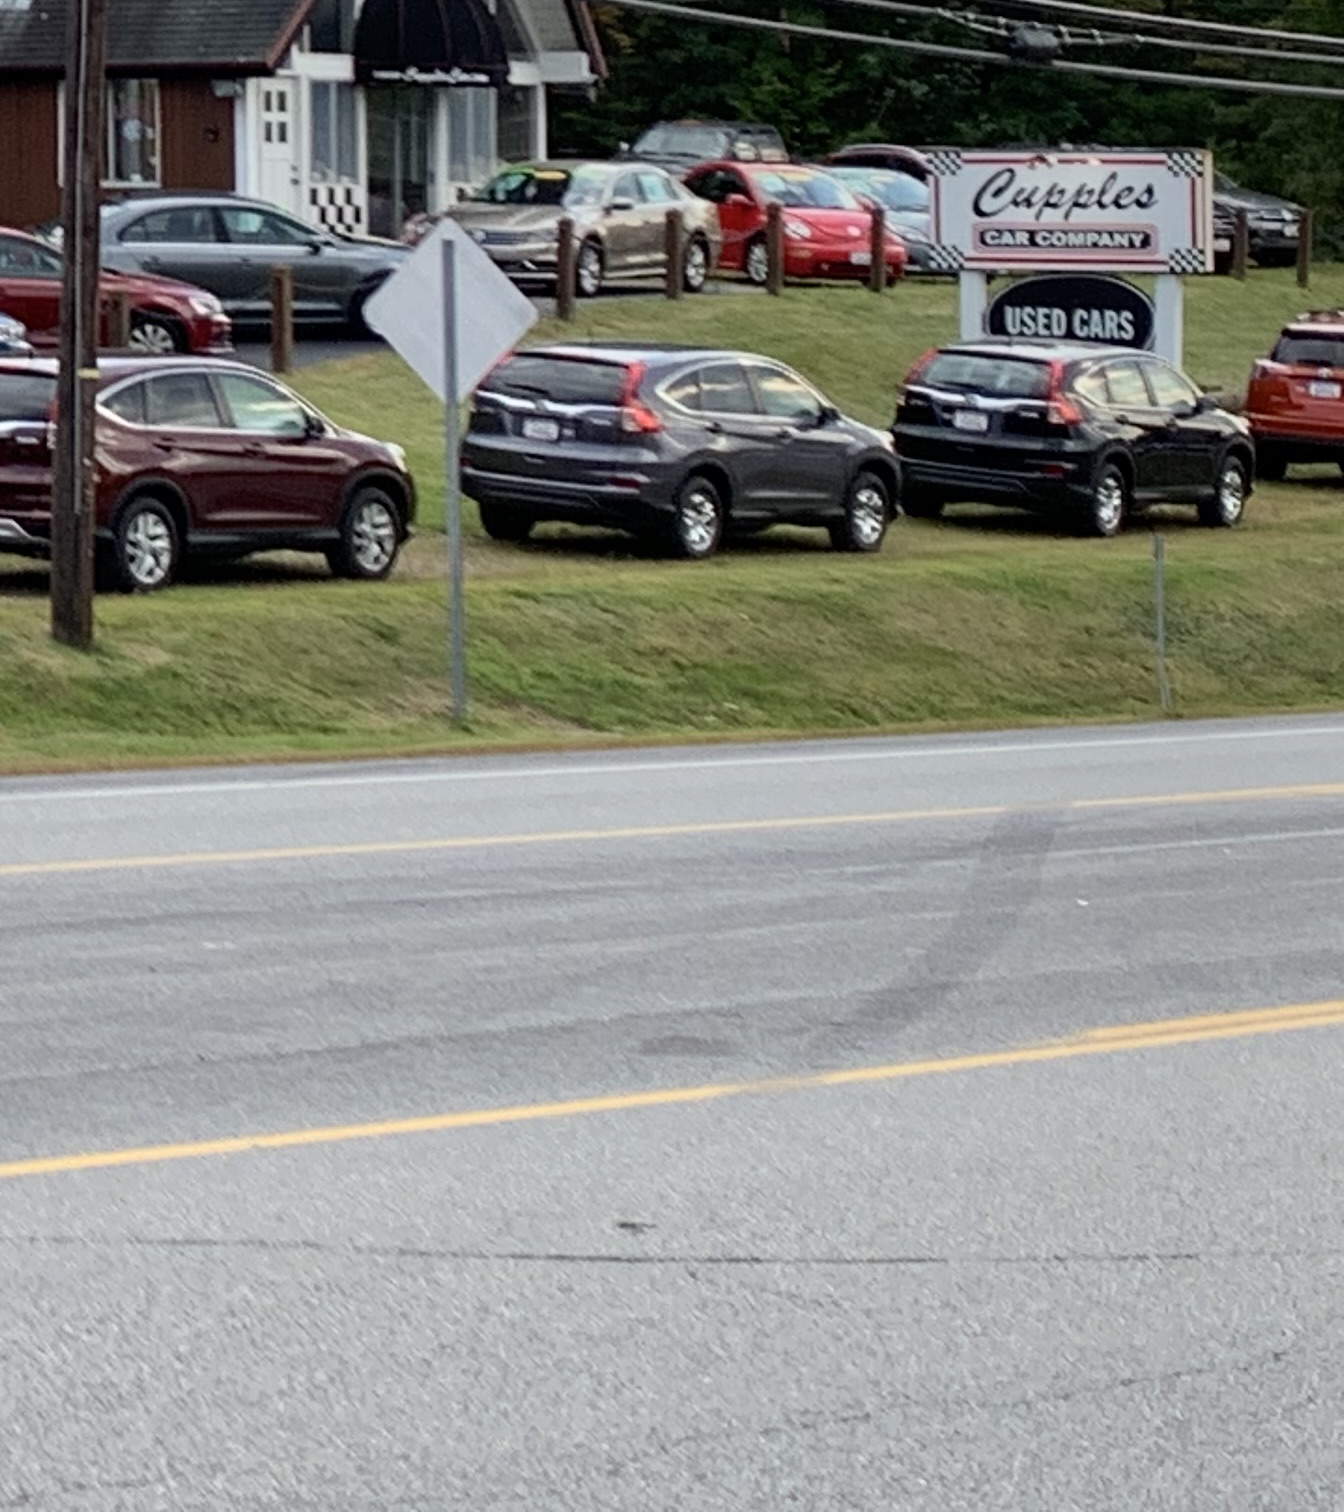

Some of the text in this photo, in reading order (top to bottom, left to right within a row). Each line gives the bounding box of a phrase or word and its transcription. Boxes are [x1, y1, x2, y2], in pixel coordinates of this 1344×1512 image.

[972, 168, 1158, 221] Cupples
[983, 230, 1144, 248] CAR COMPANY
[1003, 306, 1135, 340] USED CARS
